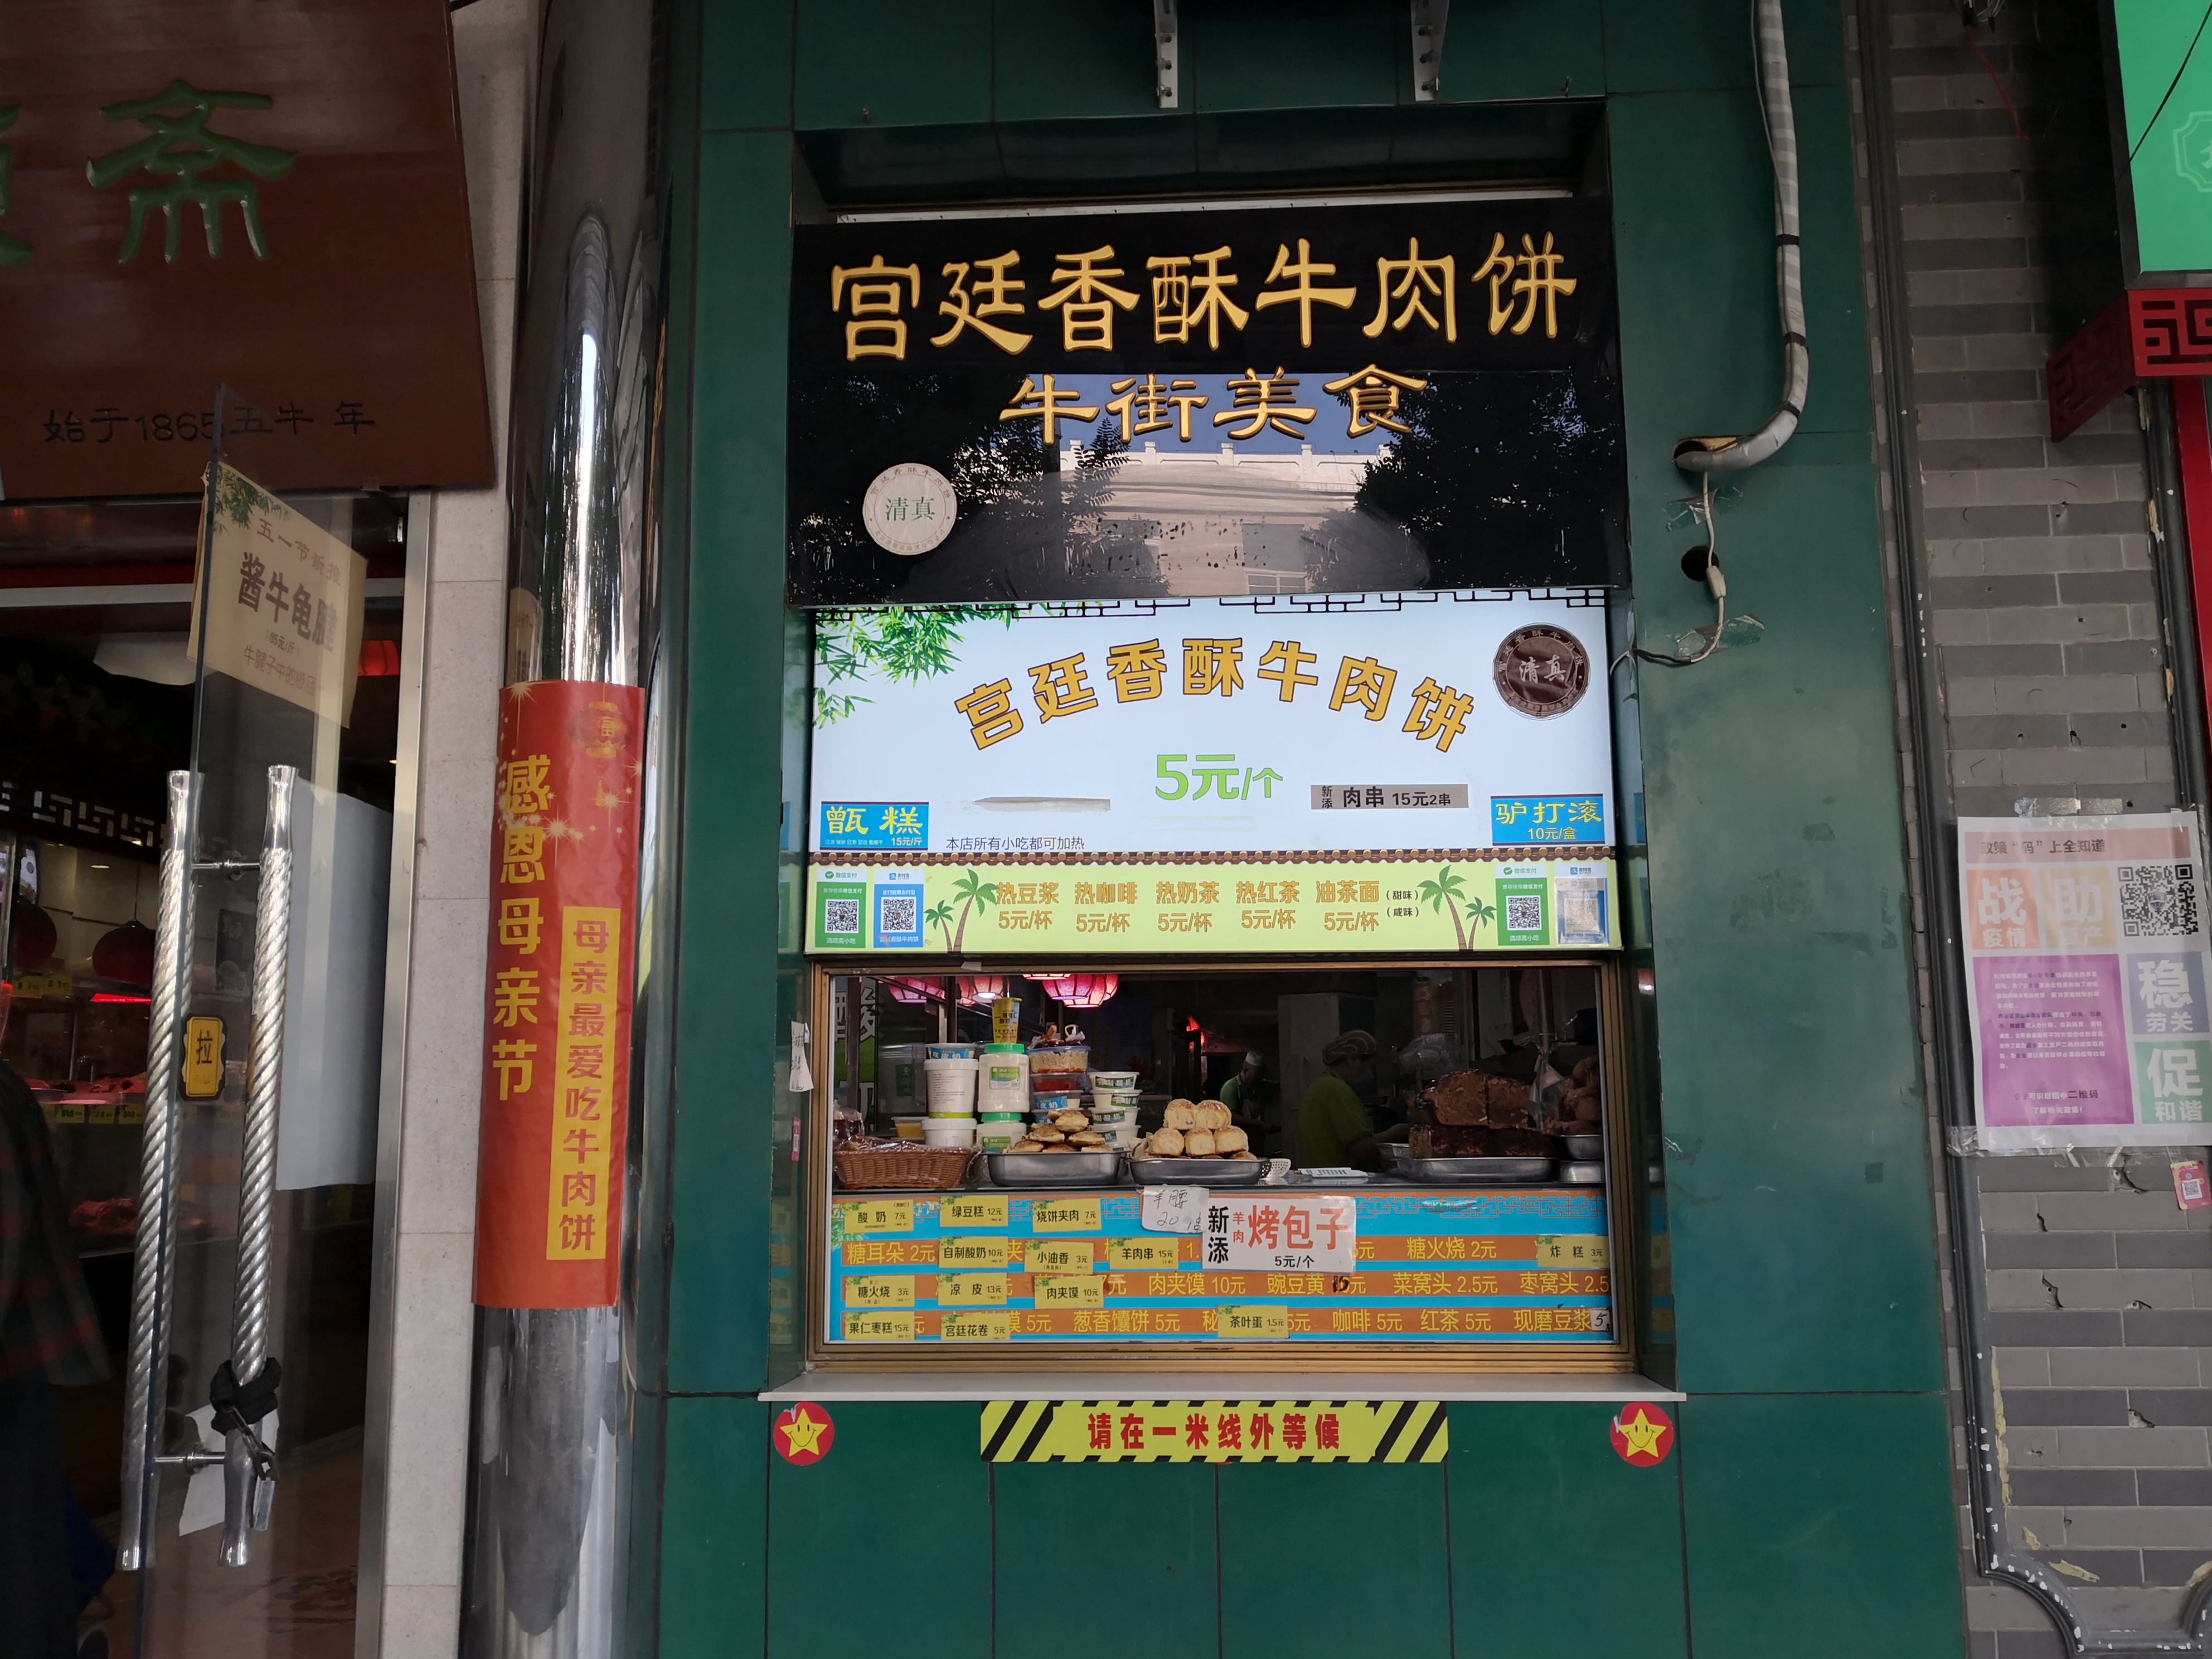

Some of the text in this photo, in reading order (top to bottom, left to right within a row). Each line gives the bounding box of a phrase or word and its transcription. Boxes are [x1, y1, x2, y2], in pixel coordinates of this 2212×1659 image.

[832, 230, 1577, 361] 宫廷香酥牛肉饼
[999, 362, 1428, 445] 牛街美食
[885, 497, 935, 522] 清真
[1519, 653, 1566, 685] 清真
[953, 637, 1474, 753] 宫廷香酥牛肉饼
[1154, 754, 1283, 801] 5元/个
[1321, 785, 1451, 809] 新添 肉串 15元2串
[826, 806, 923, 835] 甑糕
[1495, 801, 1602, 825] 驴打滚
[891, 837, 923, 847] 15元/斤
[946, 836, 1085, 852] 本店所有小吃都可加热
[1527, 827, 1577, 841] 10元/盒
[996, 881, 1060, 905] 热豆浆
[1074, 881, 1138, 905] 热咖啡
[1155, 880, 1220, 904] 热奶茶
[1235, 880, 1300, 904] 热红茶
[1316, 880, 1380, 904] 油茶面
[1977, 877, 2026, 926] 战
[2054, 875, 2103, 924] 助
[492, 754, 551, 1101] 感恩母亲节
[998, 909, 1053, 931] 5元/杯
[1075, 912, 1131, 933] 5元/杯
[1157, 911, 1212, 932] 5元/杯
[1240, 909, 1296, 930] 5元/杯
[1323, 911, 1380, 932] 5元/杯
[1982, 926, 2026, 949] 疫情
[2137, 959, 2194, 1009] 稳
[2146, 1011, 2194, 1032] 劳关
[196, 1030, 214, 1065] 拉
[2146, 1047, 2204, 1098] 促
[559, 920, 609, 1251] 母亲最爱吃牛肉饼
[2154, 1099, 2203, 1122] 和谐
[857, 1211, 906, 1224] 酸奶 7元
[952, 1205, 984, 1218] 绿豆糕
[1037, 1209, 1097, 1223] 烧饼夹肉 7元
[1157, 1211, 1179, 1226] 20
[1208, 1205, 1348, 1264] 新添 羊肉 烤包子
[847, 1241, 936, 1265] 糖耳朵 2元
[944, 1246, 1003, 1259] 自制酸奶 10元
[1037, 1251, 1088, 1265] 小油香 3元
[1122, 1248, 1153, 1260] 羊肉串
[1158, 1250, 1173, 1258] 15元
[1407, 1237, 1497, 1260] 糖火烧 2元
[1550, 1246, 1584, 1258] 炸糕
[1274, 1255, 1315, 1269] 5元/个
[858, 1286, 890, 1298] 糖火烧
[950, 1284, 982, 1296] 凉皮
[1047, 1287, 1079, 1299] 肉夹馍
[1148, 1274, 1245, 1296] 肉夹馍 10元
[1267, 1273, 1325, 1295] 豌豆黄
[1393, 1272, 1498, 1295] 菜窝头 2.5元
[1520, 1272, 1579, 1294] 枣窝头
[850, 1322, 892, 1334] 果仁枣糕
[945, 1325, 988, 1337] 宫廷花卷
[1027, 1314, 1052, 1332] 5元
[1074, 1310, 1180, 1332] 葱香馕饼 5元
[1230, 1316, 1262, 1328] 茶叶蛋
[1333, 1309, 1403, 1332] 咖啡 5元
[1420, 1309, 1491, 1331] 红茶 5元
[1514, 1308, 1593, 1331] 现磨豆浆
[1087, 1412, 1341, 1451] 请在一米线外等候
